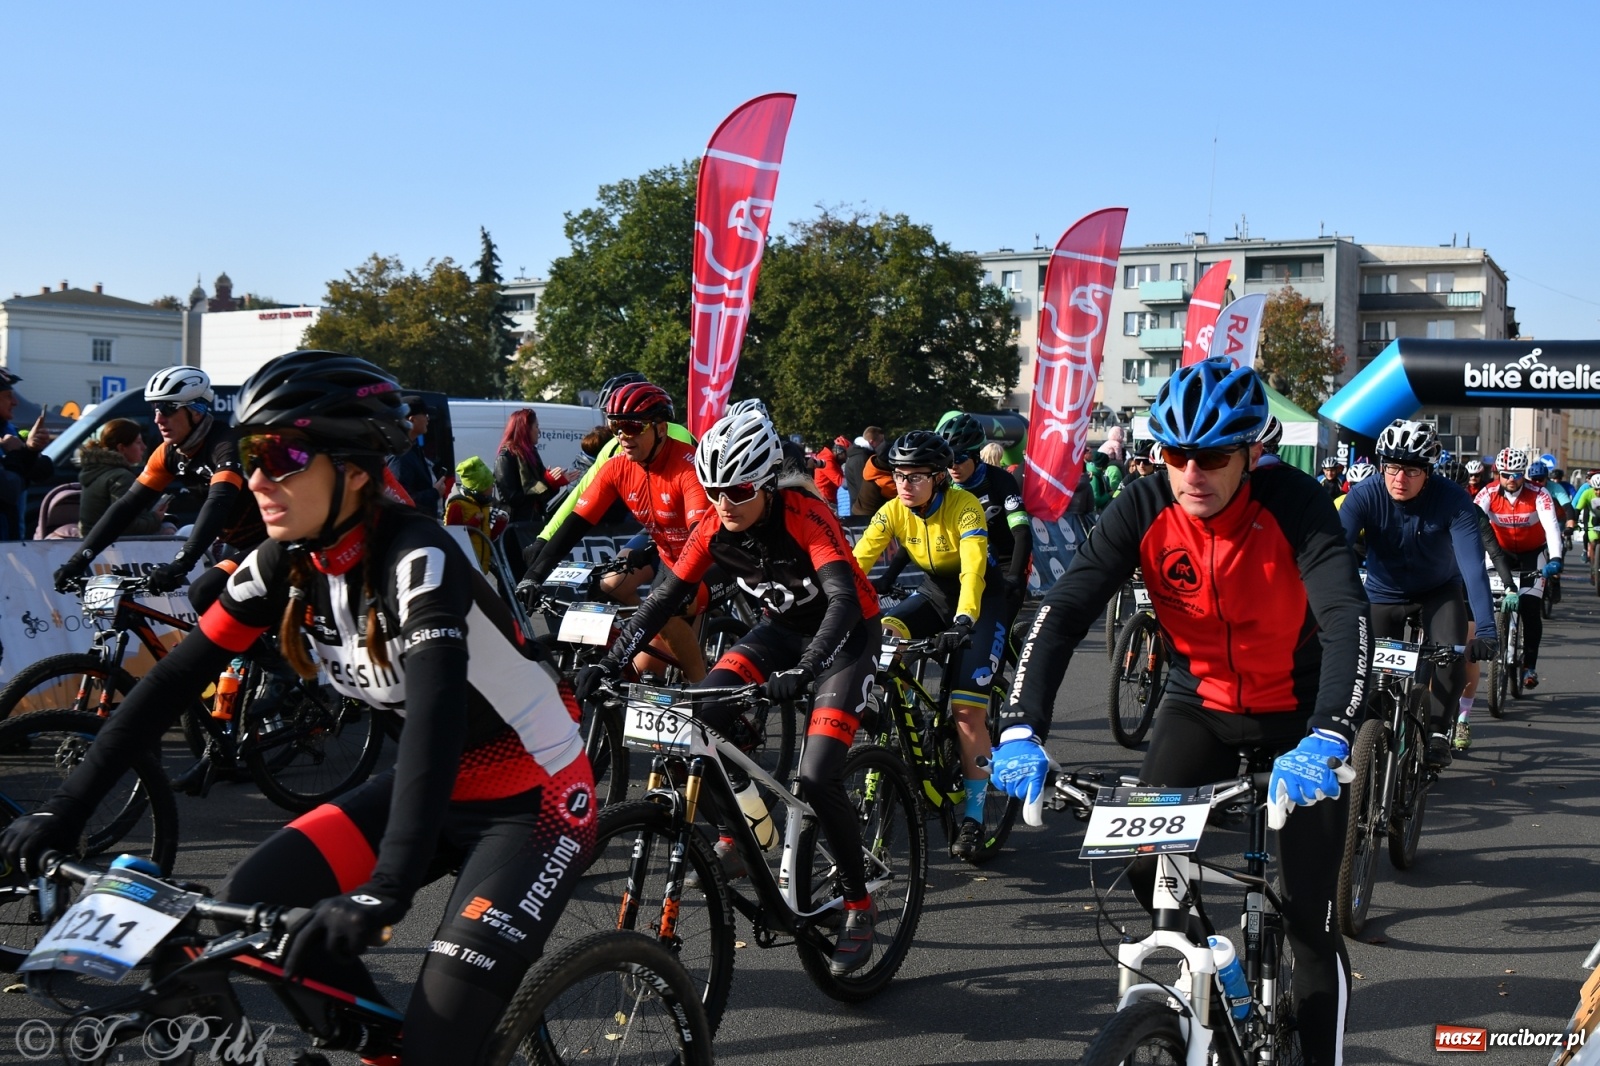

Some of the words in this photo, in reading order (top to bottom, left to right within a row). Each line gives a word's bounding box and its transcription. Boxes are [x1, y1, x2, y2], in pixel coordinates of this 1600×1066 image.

[1464, 362, 1522, 389] bike
[554, 570, 582, 581] 2247
[1027, 605, 1051, 640] GRUPA
[1346, 678, 1365, 718] GRUPA
[1356, 616, 1368, 677] KOLARSKA
[1375, 652, 1407, 667] 245
[1009, 642, 1034, 706] KOLARSKA
[635, 710, 679, 734] 1363
[1279, 759, 1324, 780] VELCRO
[1106, 815, 1186, 838] 2898
[517, 834, 581, 921] pressing
[52, 909, 139, 949] 1211
[459, 947, 497, 971] TEAM
